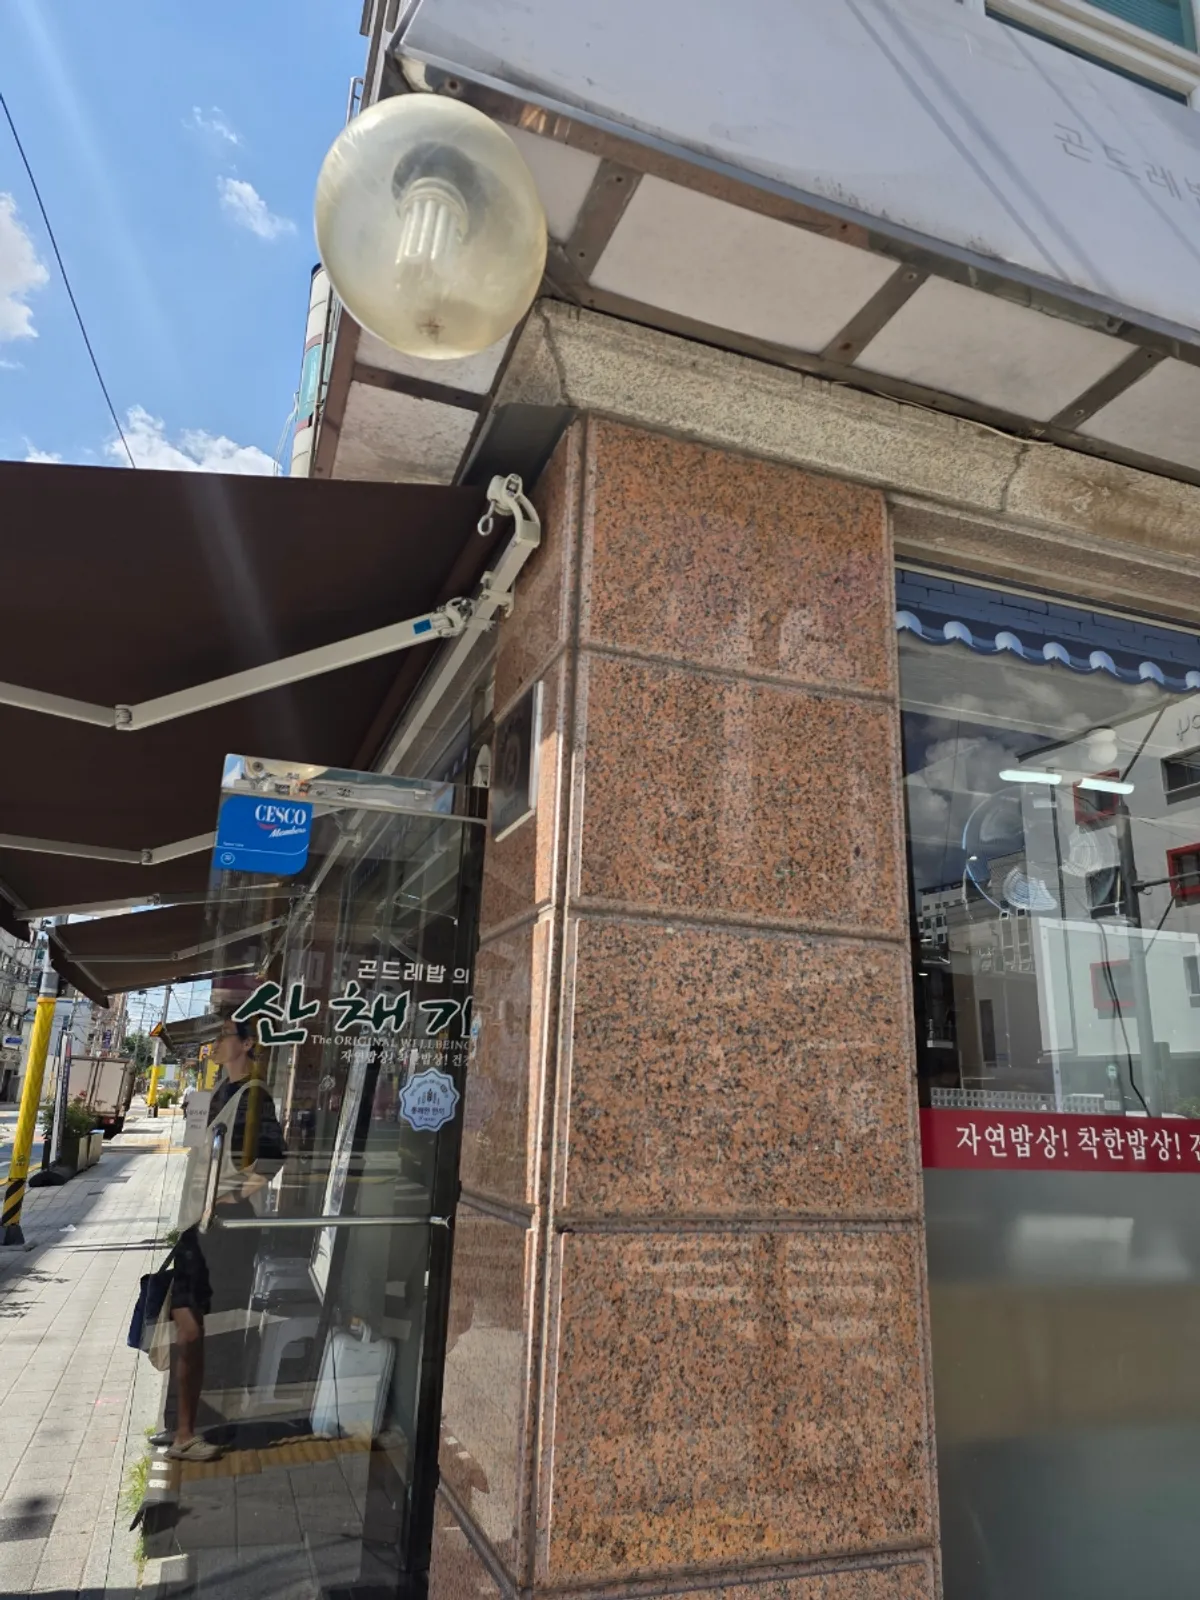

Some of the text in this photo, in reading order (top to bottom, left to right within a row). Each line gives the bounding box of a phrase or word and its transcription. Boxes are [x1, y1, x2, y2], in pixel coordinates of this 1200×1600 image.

[255, 804, 306, 825] CESCO
[357, 960, 446, 983] 곤드레밥
[311, 1034, 332, 1045] The
[334, 1036, 397, 1048] ORIGINAL
[956, 1123, 1069, 1159] 자연밥상!
[1077, 1126, 1182, 1162] 착한밥상!
